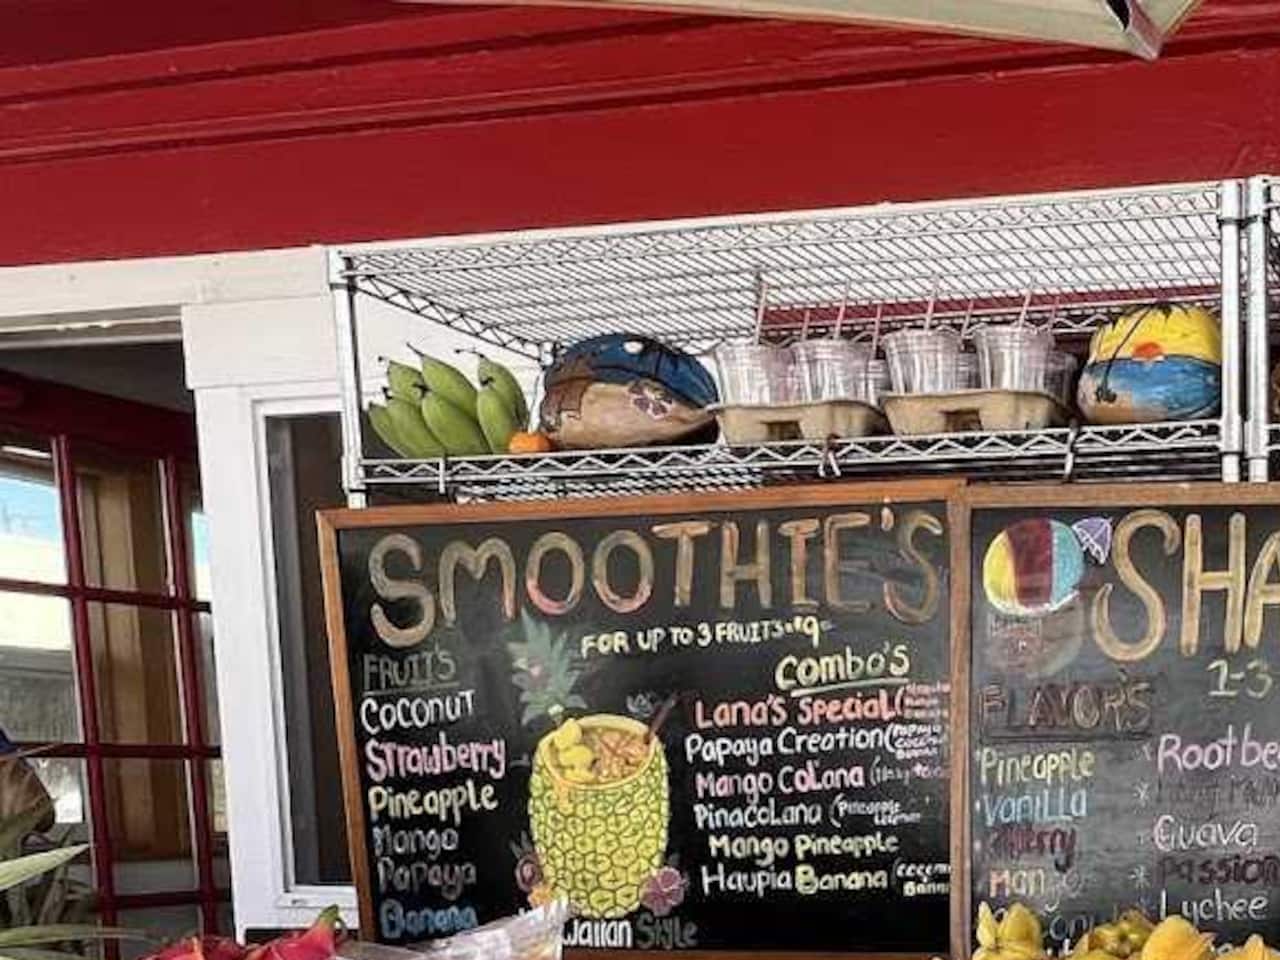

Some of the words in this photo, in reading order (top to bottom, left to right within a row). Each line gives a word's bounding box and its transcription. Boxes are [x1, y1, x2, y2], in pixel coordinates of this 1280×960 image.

[368, 501, 945, 648] SMOOTHIE'S
[581, 630, 630, 659] FOR
[636, 628, 667, 652] UP
[671, 626, 693, 646] TO
[697, 624, 711, 648] 3
[685, 733, 774, 767] Papaya
[980, 747, 1095, 786] Pineapple
[367, 779, 499, 825] Pineapple
[695, 771, 773, 803] Mango
[372, 824, 460, 859] Mango
[708, 834, 789, 866] Mango
[794, 831, 900, 859] Pineapple
[1153, 814, 1258, 851] Guava
[701, 864, 792, 897] Haupia
[795, 864, 888, 895] Banana
[380, 899, 479, 939] Banana
[634, 911, 698, 950] Style
